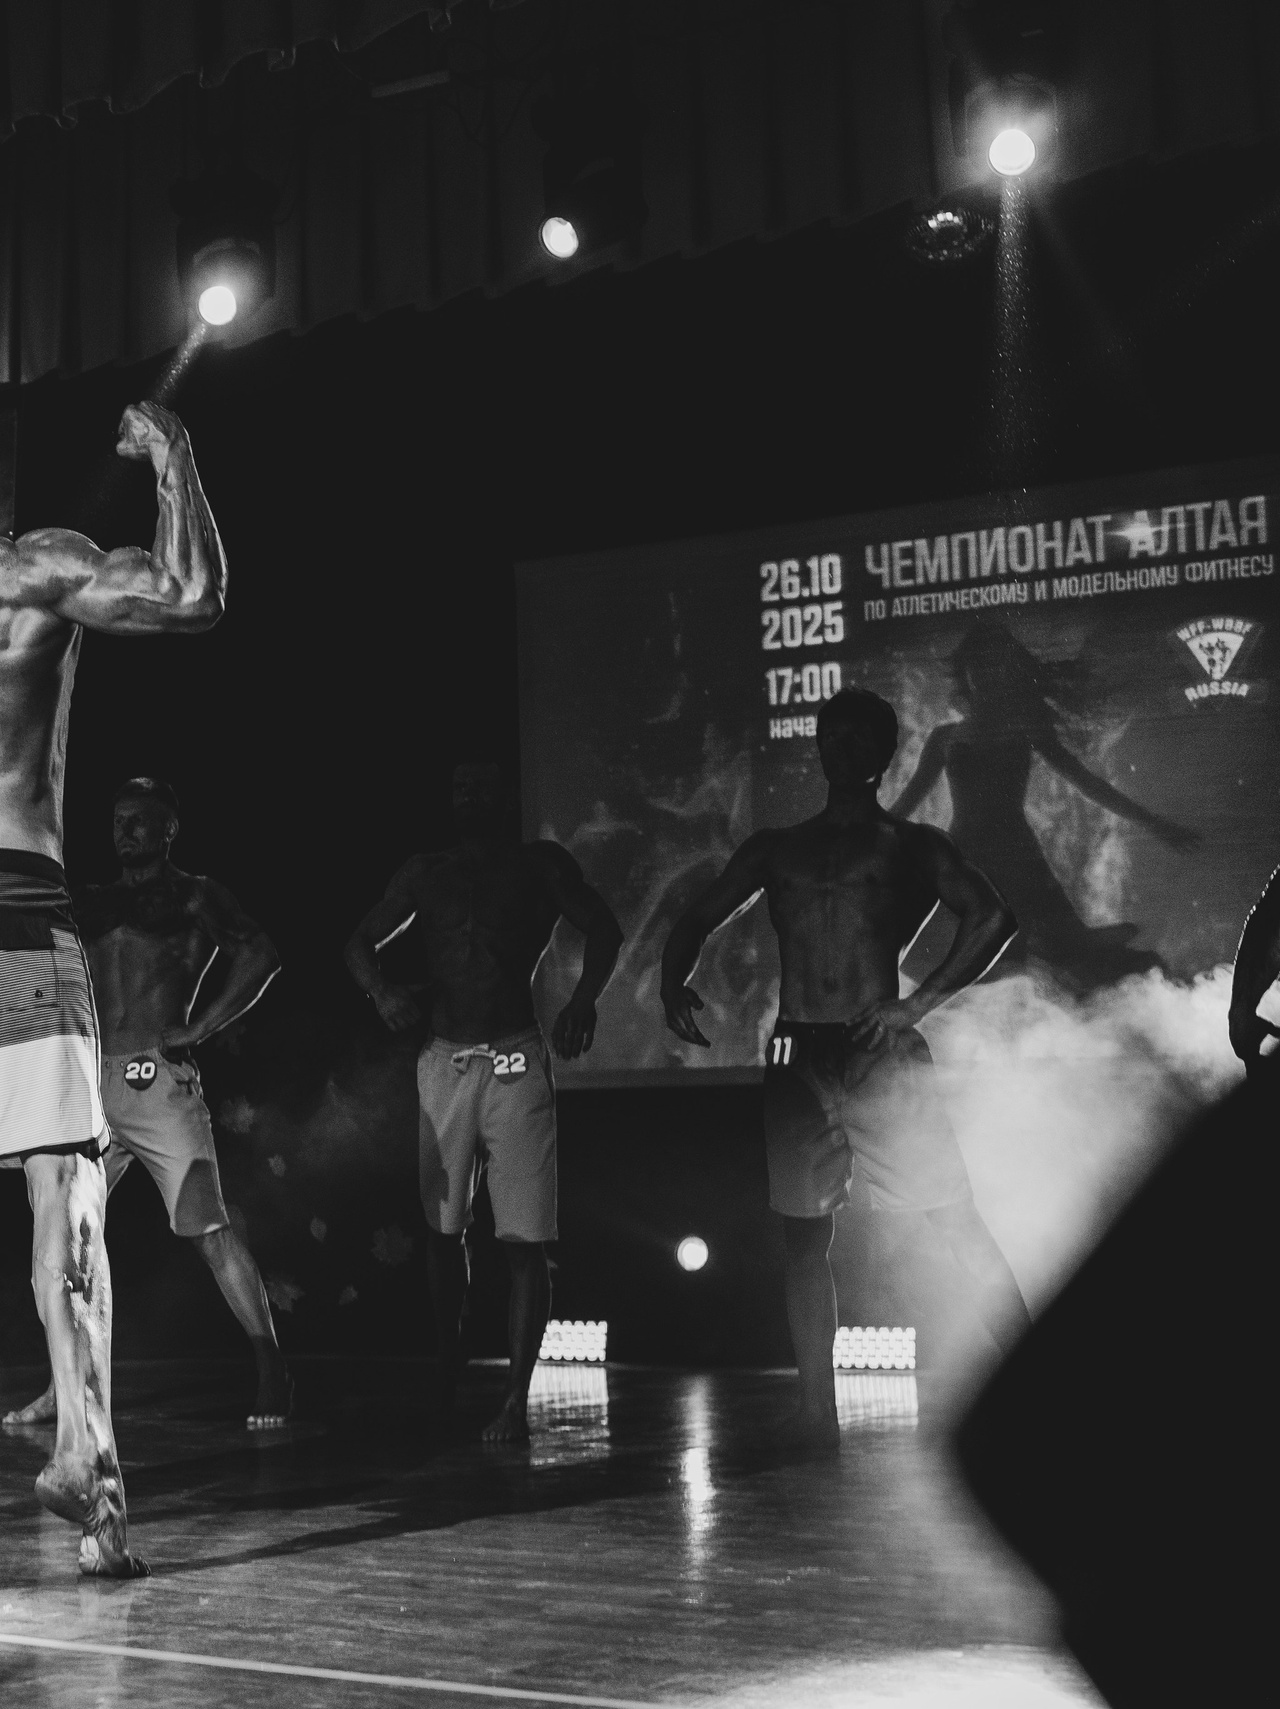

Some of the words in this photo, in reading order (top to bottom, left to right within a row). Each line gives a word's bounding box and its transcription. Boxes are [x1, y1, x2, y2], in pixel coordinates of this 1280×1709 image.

[865, 514, 1112, 589] ЧЕМПИОНАТ
[1128, 495, 1268, 559] АЛТАЯ
[760, 553, 842, 602] 26.10
[864, 600, 887, 622] ПО
[892, 582, 1028, 618] АТЛЕТИЧЕСКОМУ
[1035, 580, 1047, 601] И
[1052, 565, 1179, 600] МОДЕЛЬНОМУ
[1185, 554, 1274, 583] ФИТНЕСУ
[761, 601, 845, 650] 2025
[765, 661, 842, 706] 17:00
[1184, 680, 1250, 702] RUSSIA
[769, 715, 818, 740] нача
[493, 1052, 527, 1075] 22
[773, 1036, 792, 1066] 11
[125, 1061, 156, 1080] 20
